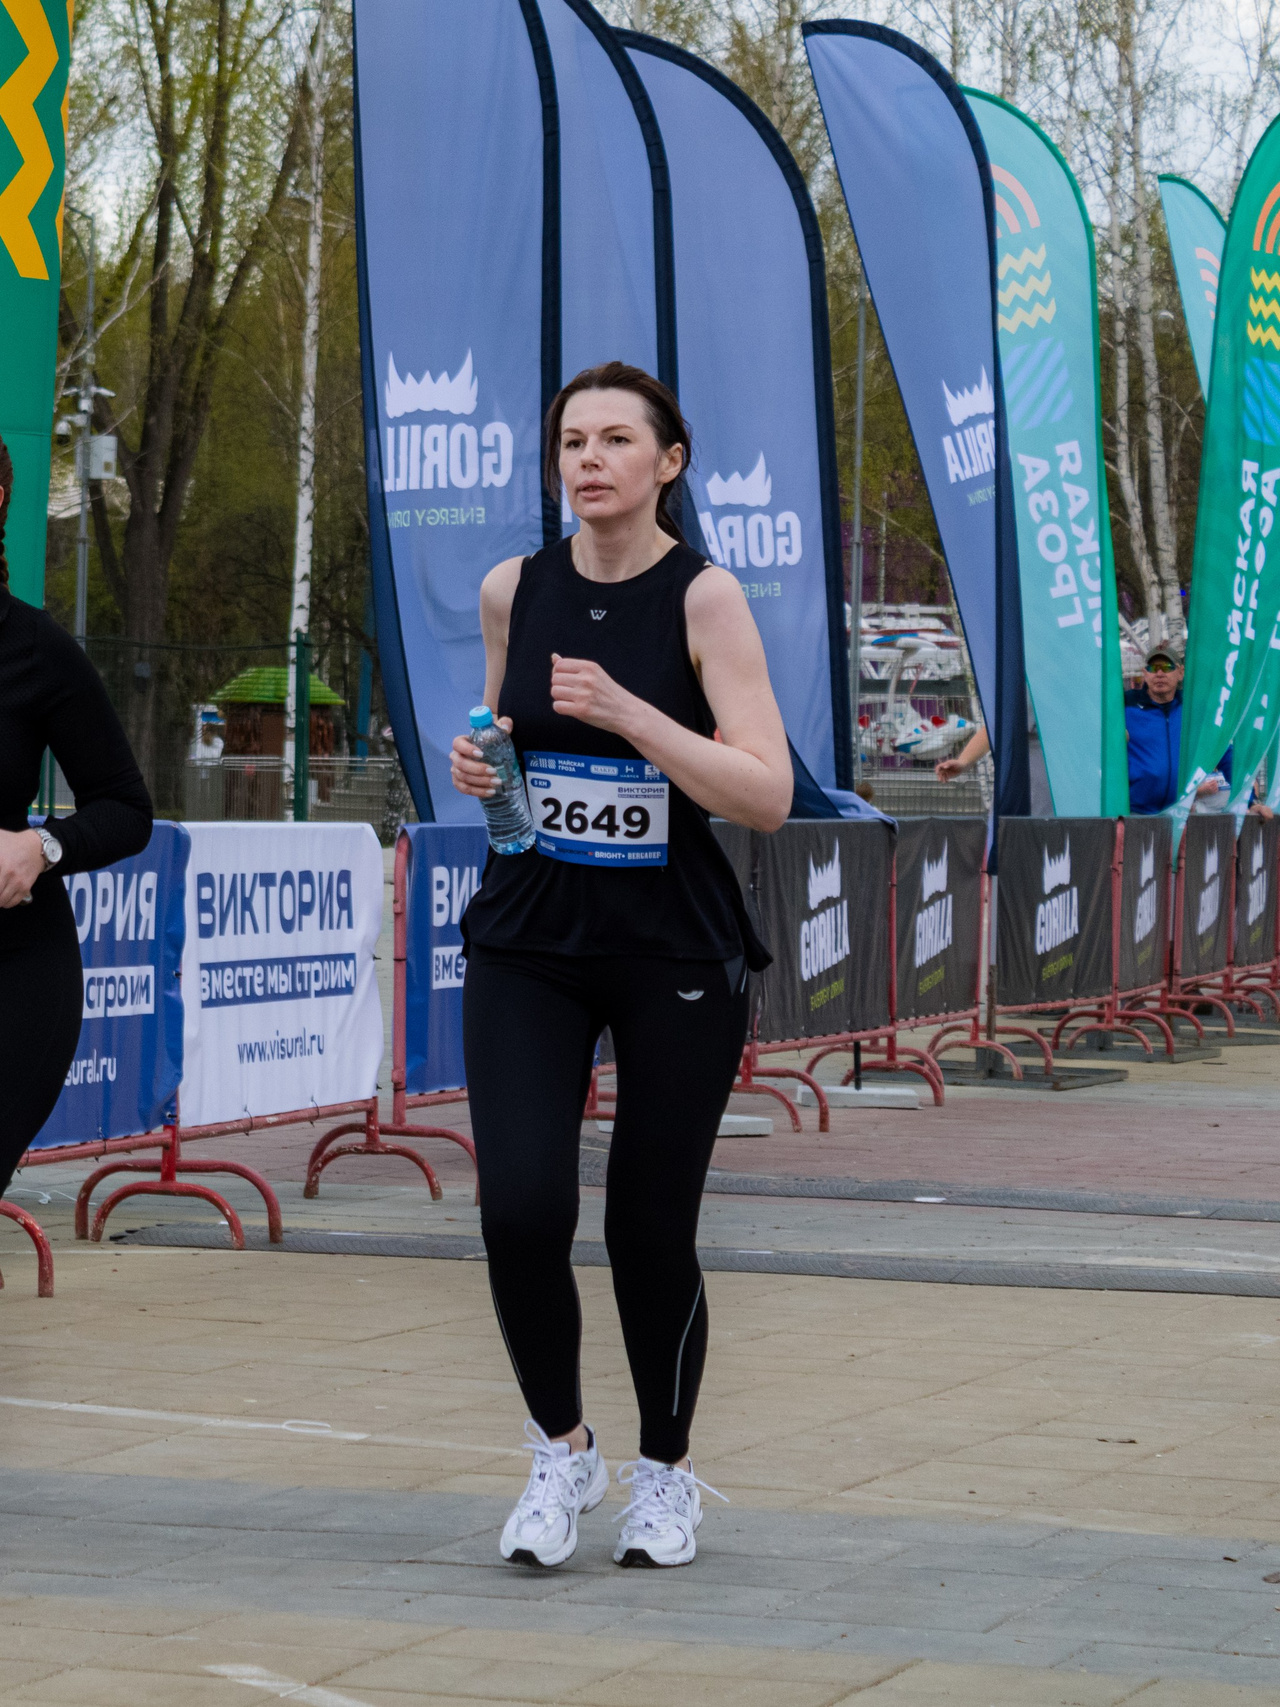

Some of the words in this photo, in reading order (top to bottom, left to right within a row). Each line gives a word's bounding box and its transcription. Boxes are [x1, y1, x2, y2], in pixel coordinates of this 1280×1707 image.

[617, 786, 665, 794] ВИКТОРИЯ
[541, 797, 651, 839] 2649
[63, 870, 159, 945] ОРИЯ
[196, 869, 354, 939] ВИКТОРИЯ
[1035, 886, 1079, 956] GORILLA
[800, 899, 850, 982] GORILLA
[85, 973, 151, 1018] строим
[200, 964, 264, 1002] вместе
[267, 963, 293, 995] мы
[295, 958, 356, 999] строим
[237, 1027, 325, 1065] www.visural.ru
